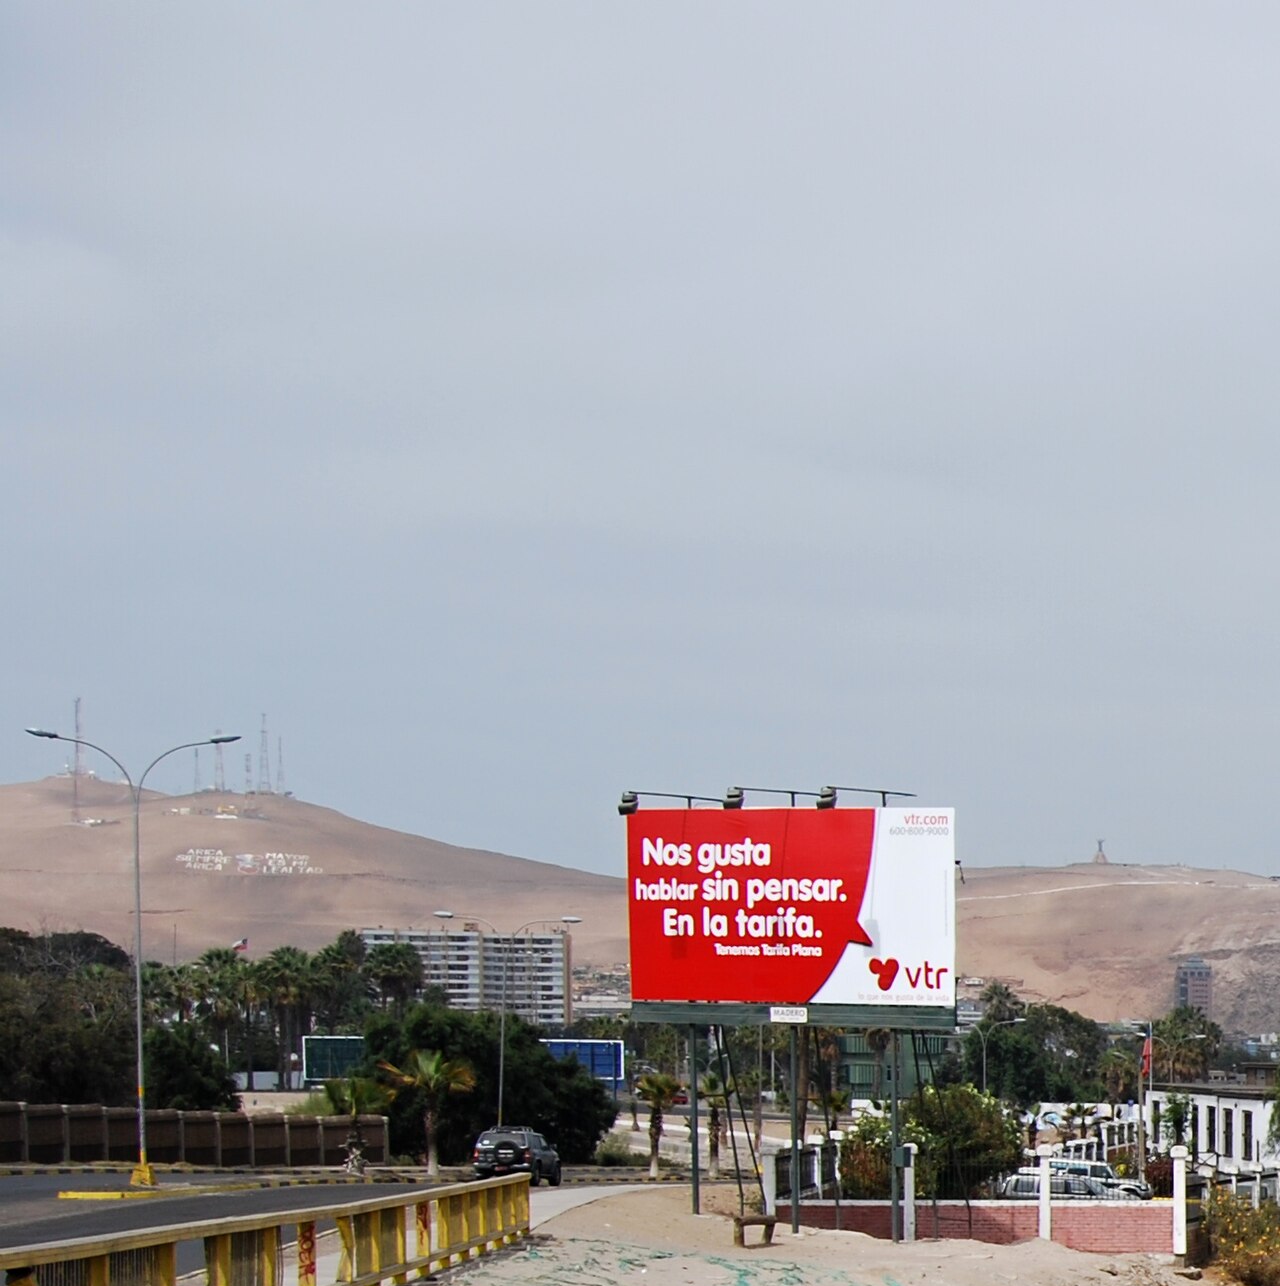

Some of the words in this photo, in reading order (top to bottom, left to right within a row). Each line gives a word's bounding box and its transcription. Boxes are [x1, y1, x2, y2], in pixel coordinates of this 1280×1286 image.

[889, 827, 949, 835] 600-800-9000
[904, 814, 948, 825] vtr.com
[642, 837, 692, 866] Nos
[697, 837, 771, 873] gusta
[635, 878, 698, 901] hablar
[702, 870, 739, 901] sin
[746, 878, 847, 909] pensar.
[663, 908, 695, 937] En
[703, 906, 728, 937] la
[735, 906, 823, 938] tarifa.
[714, 943, 760, 956] Tenemos
[761, 943, 790, 956] Tarifa
[791, 944, 822, 957] Plana
[905, 961, 948, 989] vtr
